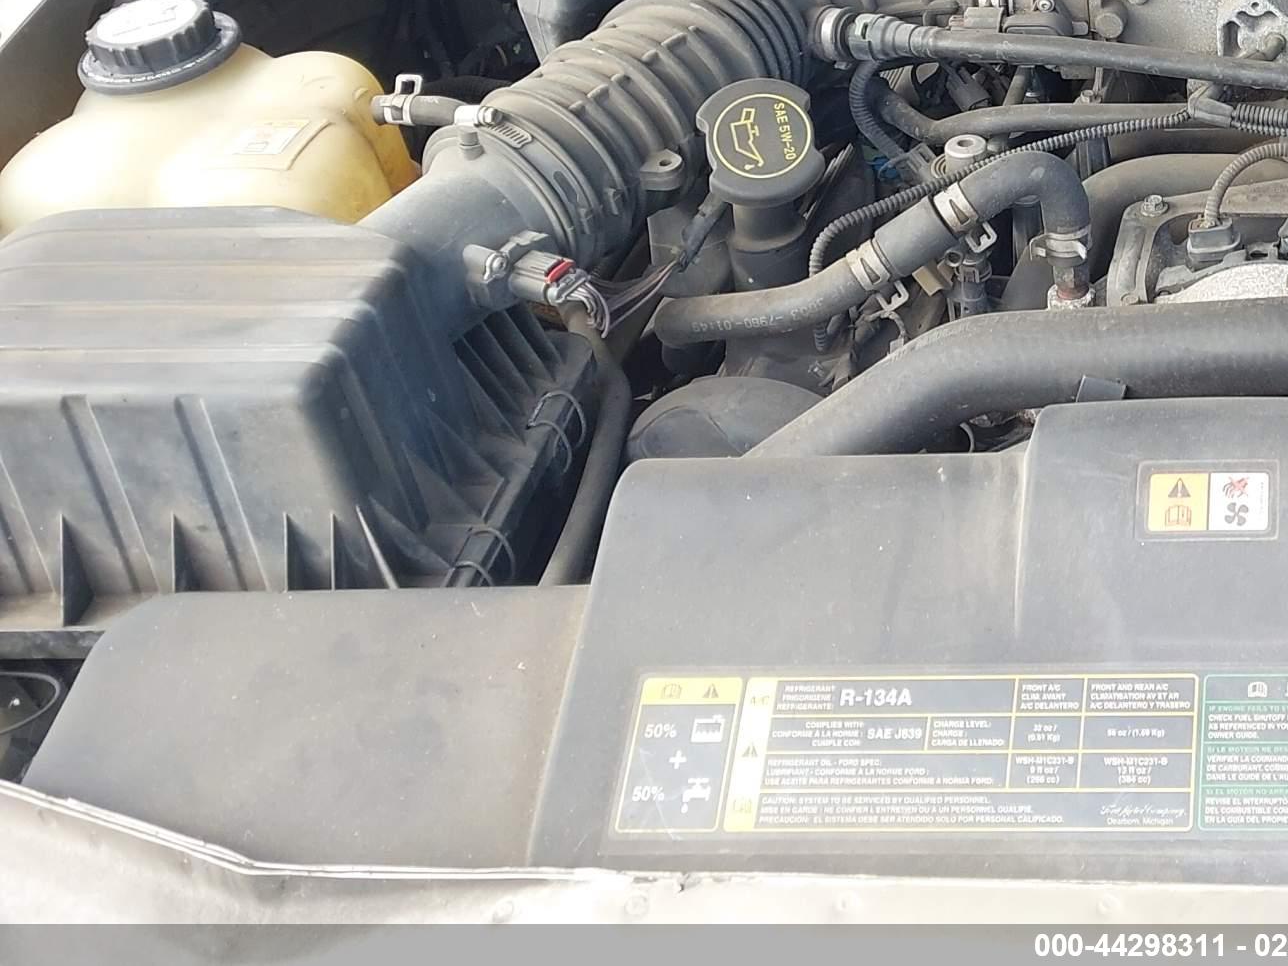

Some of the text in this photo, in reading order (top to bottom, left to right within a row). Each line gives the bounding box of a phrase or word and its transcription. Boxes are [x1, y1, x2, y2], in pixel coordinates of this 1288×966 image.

[773, 101, 798, 161] SAE 5W-20
[840, 687, 913, 707] R-134A
[644, 724, 677, 738] 50%
[867, 728, 892, 740] SAE
[632, 786, 665, 802] 50%
